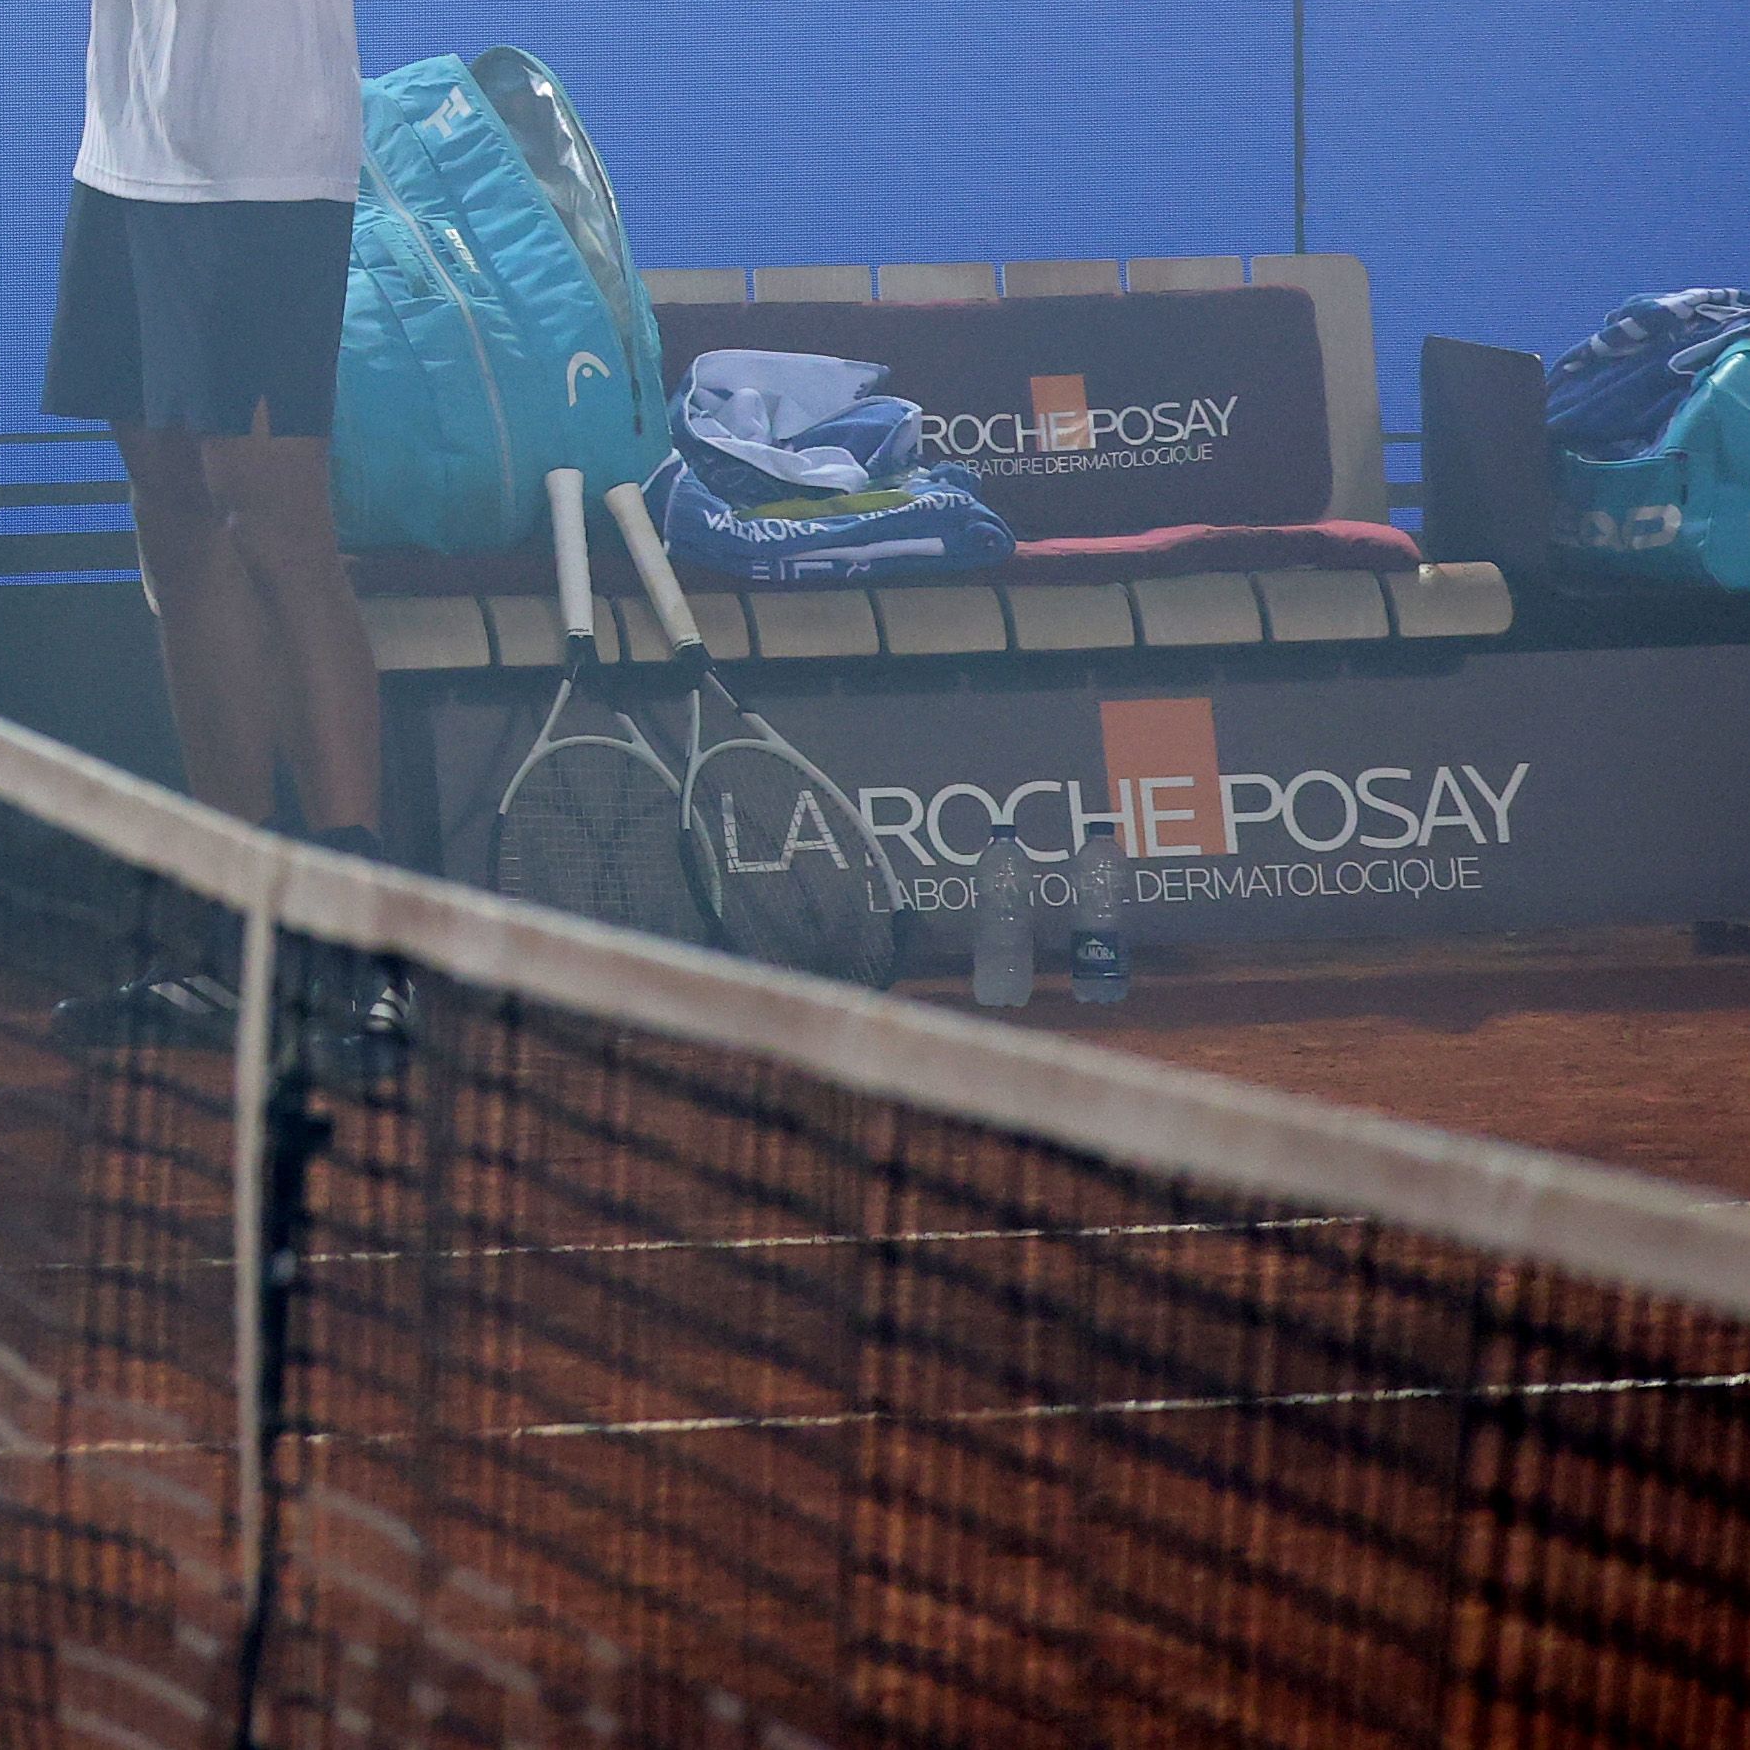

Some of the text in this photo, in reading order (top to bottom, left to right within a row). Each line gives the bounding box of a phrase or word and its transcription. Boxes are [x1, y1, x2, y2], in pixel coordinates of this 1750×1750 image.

[916, 395, 1239, 456] ROCHE POSAY
[1045, 443, 1213, 475] DERMATOLOGIQUE
[720, 762, 1529, 873] LA ROCHE POSAY
[1133, 856, 1484, 906] DERMATOLOGIQUE
